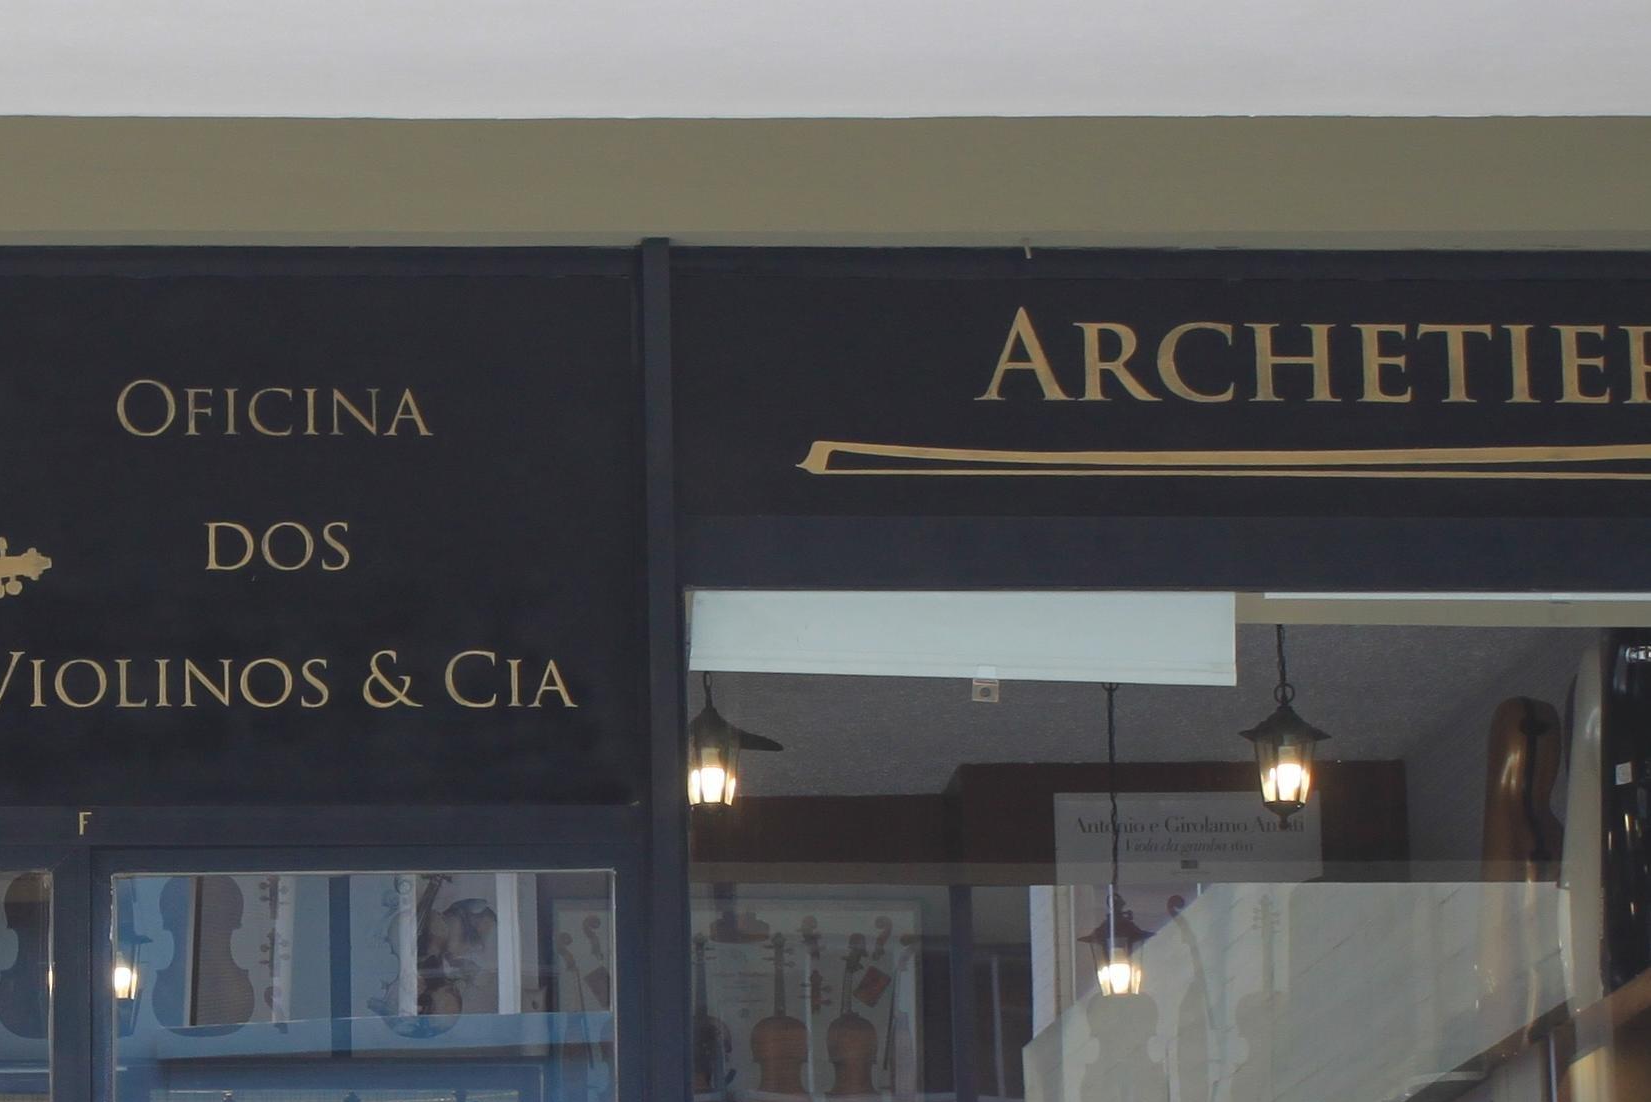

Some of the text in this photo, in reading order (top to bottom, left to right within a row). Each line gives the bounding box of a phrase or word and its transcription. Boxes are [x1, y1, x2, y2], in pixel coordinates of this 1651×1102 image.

[117, 379, 434, 437] OFICINA
[204, 521, 351, 571] DOS
[362, 649, 424, 708] &
[445, 649, 579, 708] CIA
[78, 811, 93, 836] F
[1149, 820, 1160, 834] e
[1164, 815, 1248, 834] Girolamo
[1252, 815, 1305, 834] Amti
